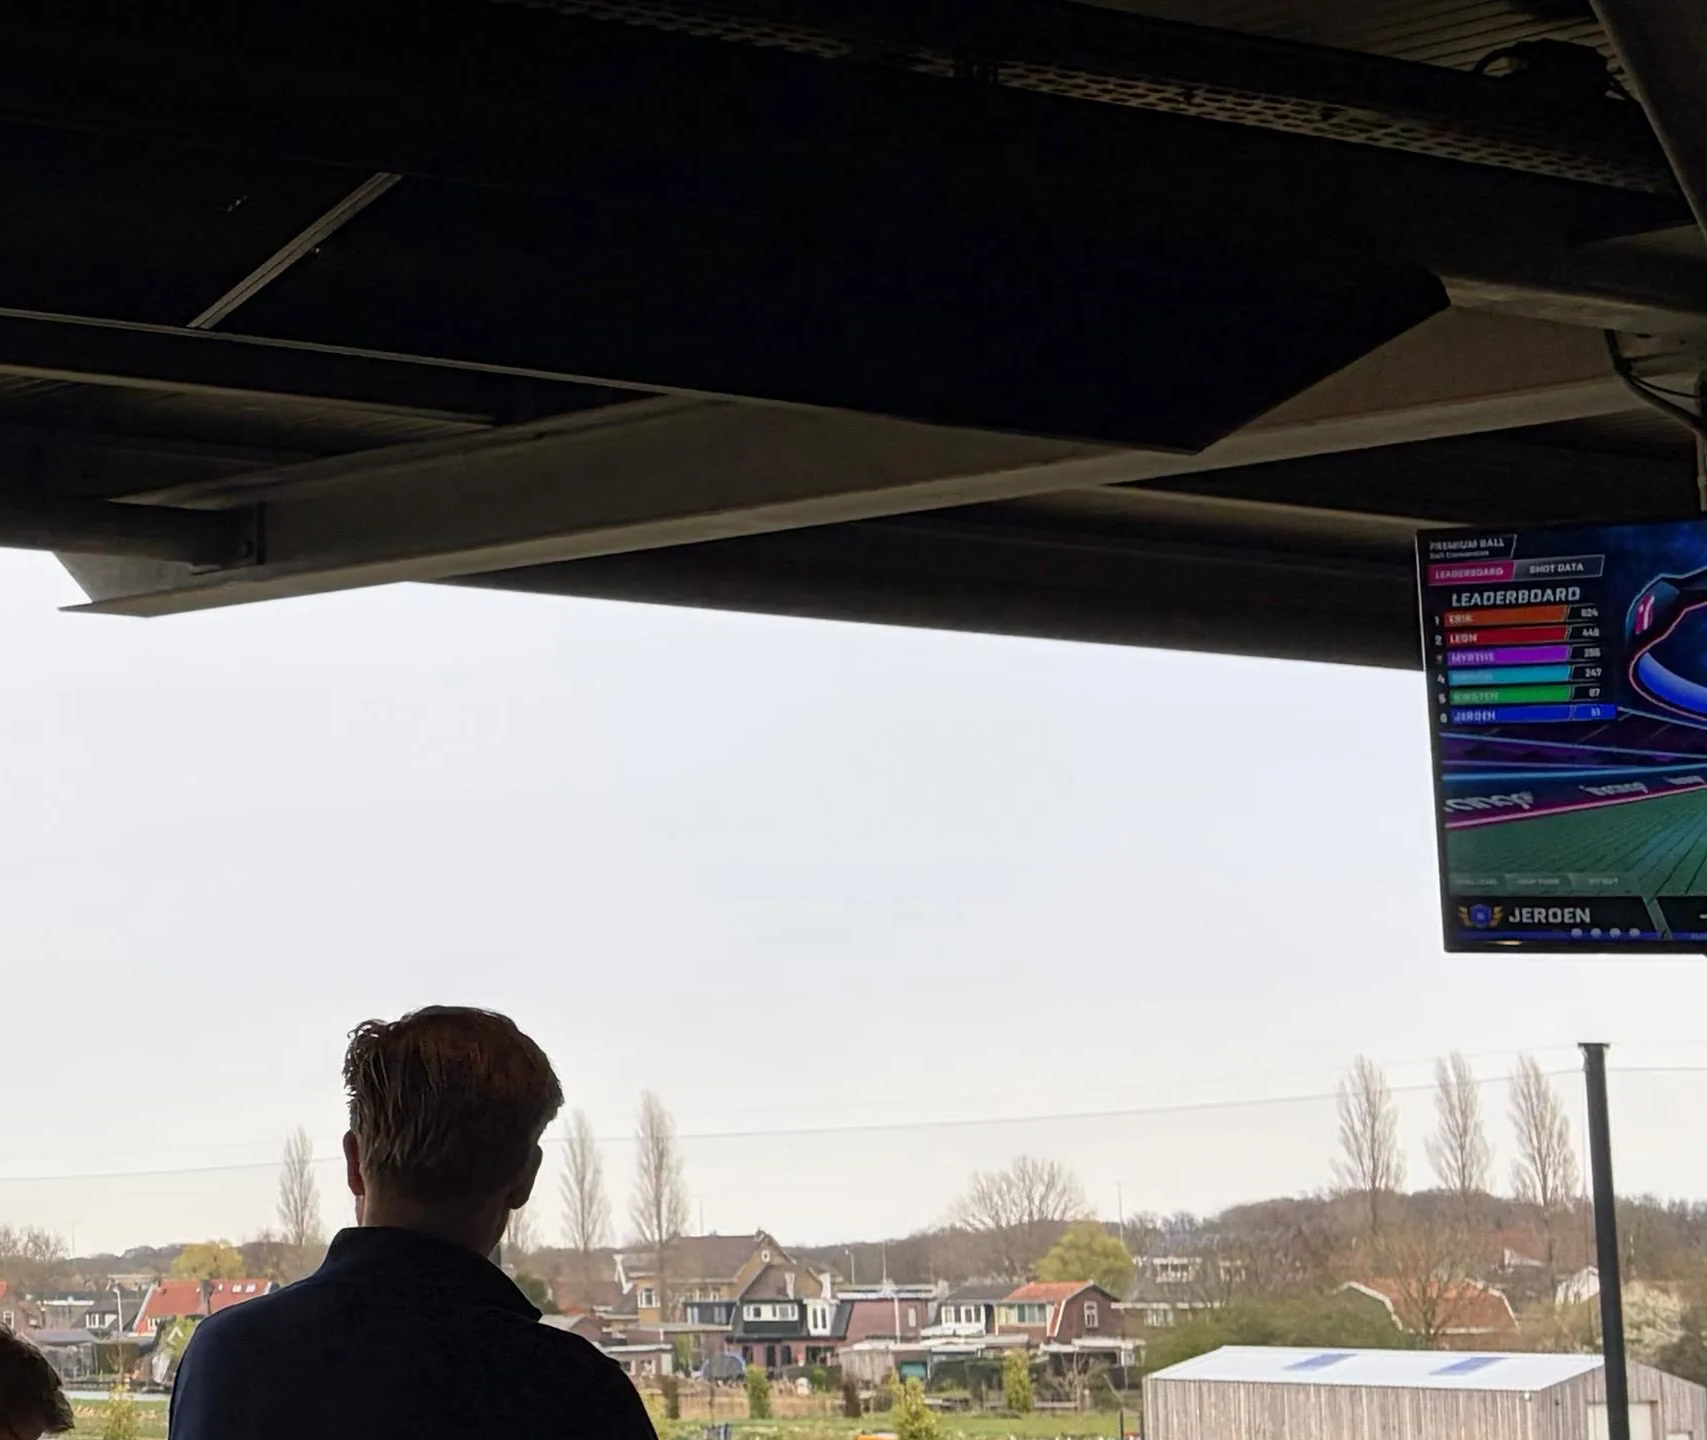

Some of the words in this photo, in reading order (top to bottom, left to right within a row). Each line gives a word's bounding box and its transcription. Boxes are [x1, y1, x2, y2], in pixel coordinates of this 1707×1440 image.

[1429, 539, 1478, 552] PREMIUM
[1479, 537, 1505, 548] BALL
[1435, 568, 1504, 579] LEADERBOARD
[1529, 564, 1555, 574] SHOT
[1558, 562, 1584, 573] DATA
[1451, 586, 1581, 608] LEADERBOARD
[1434, 635, 1442, 646] 2
[1449, 633, 1478, 644] LEON
[1508, 906, 1591, 924] JEROEN
